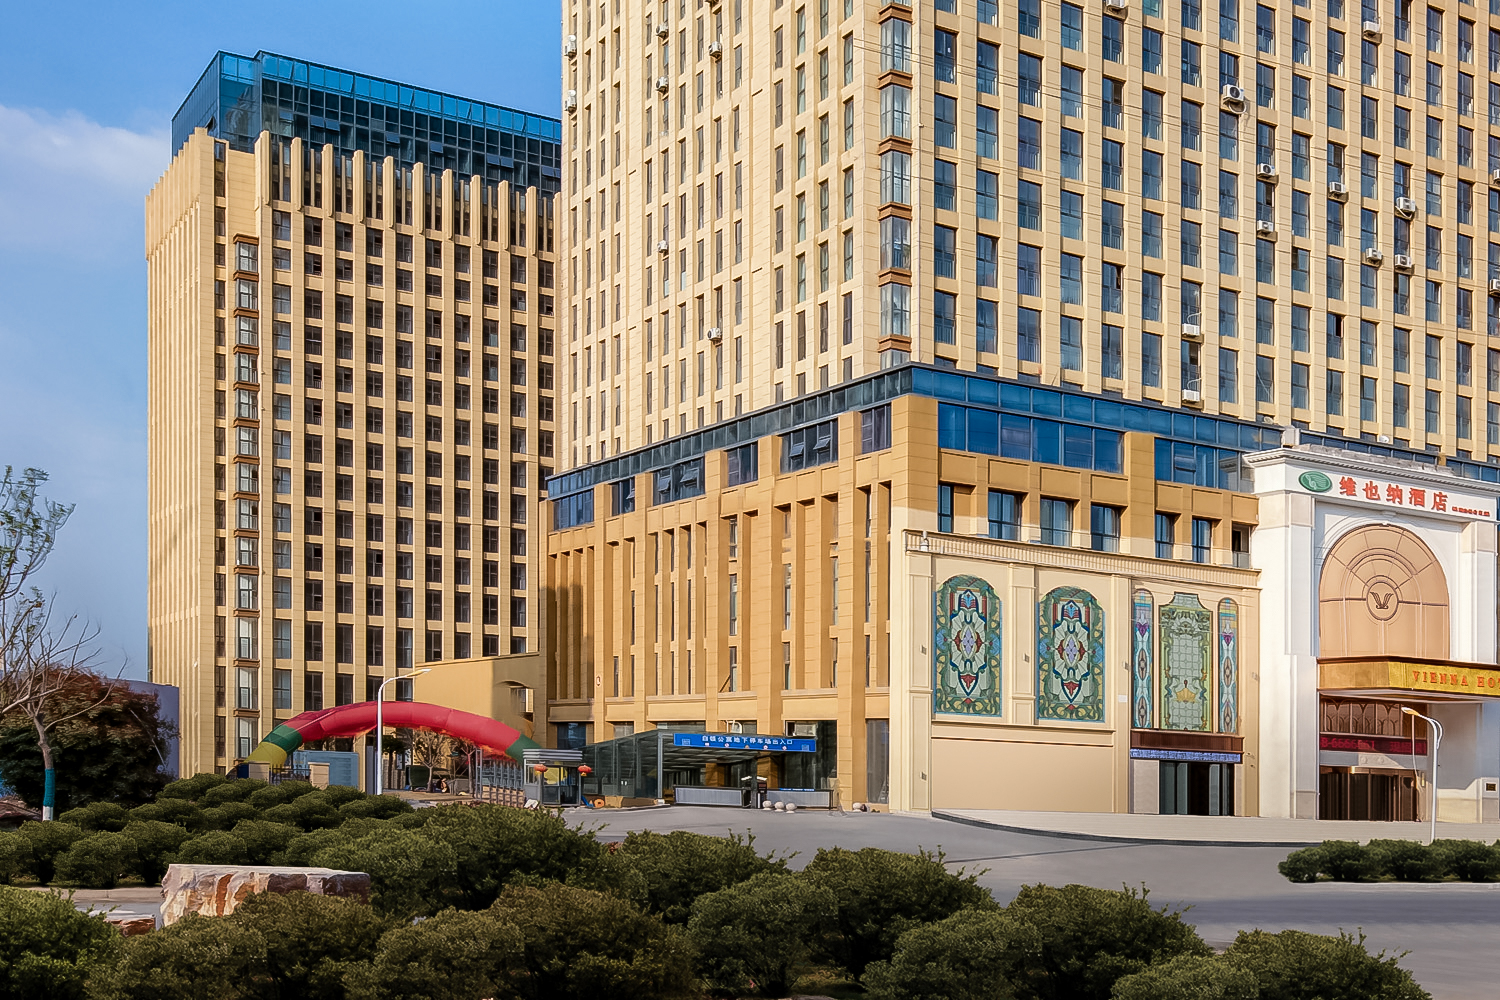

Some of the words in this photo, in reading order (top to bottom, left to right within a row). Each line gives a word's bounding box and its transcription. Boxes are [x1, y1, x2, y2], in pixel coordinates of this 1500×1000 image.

[1339, 475, 1449, 513] 维也纳酒店
[1412, 670, 1469, 687] VIENNA
